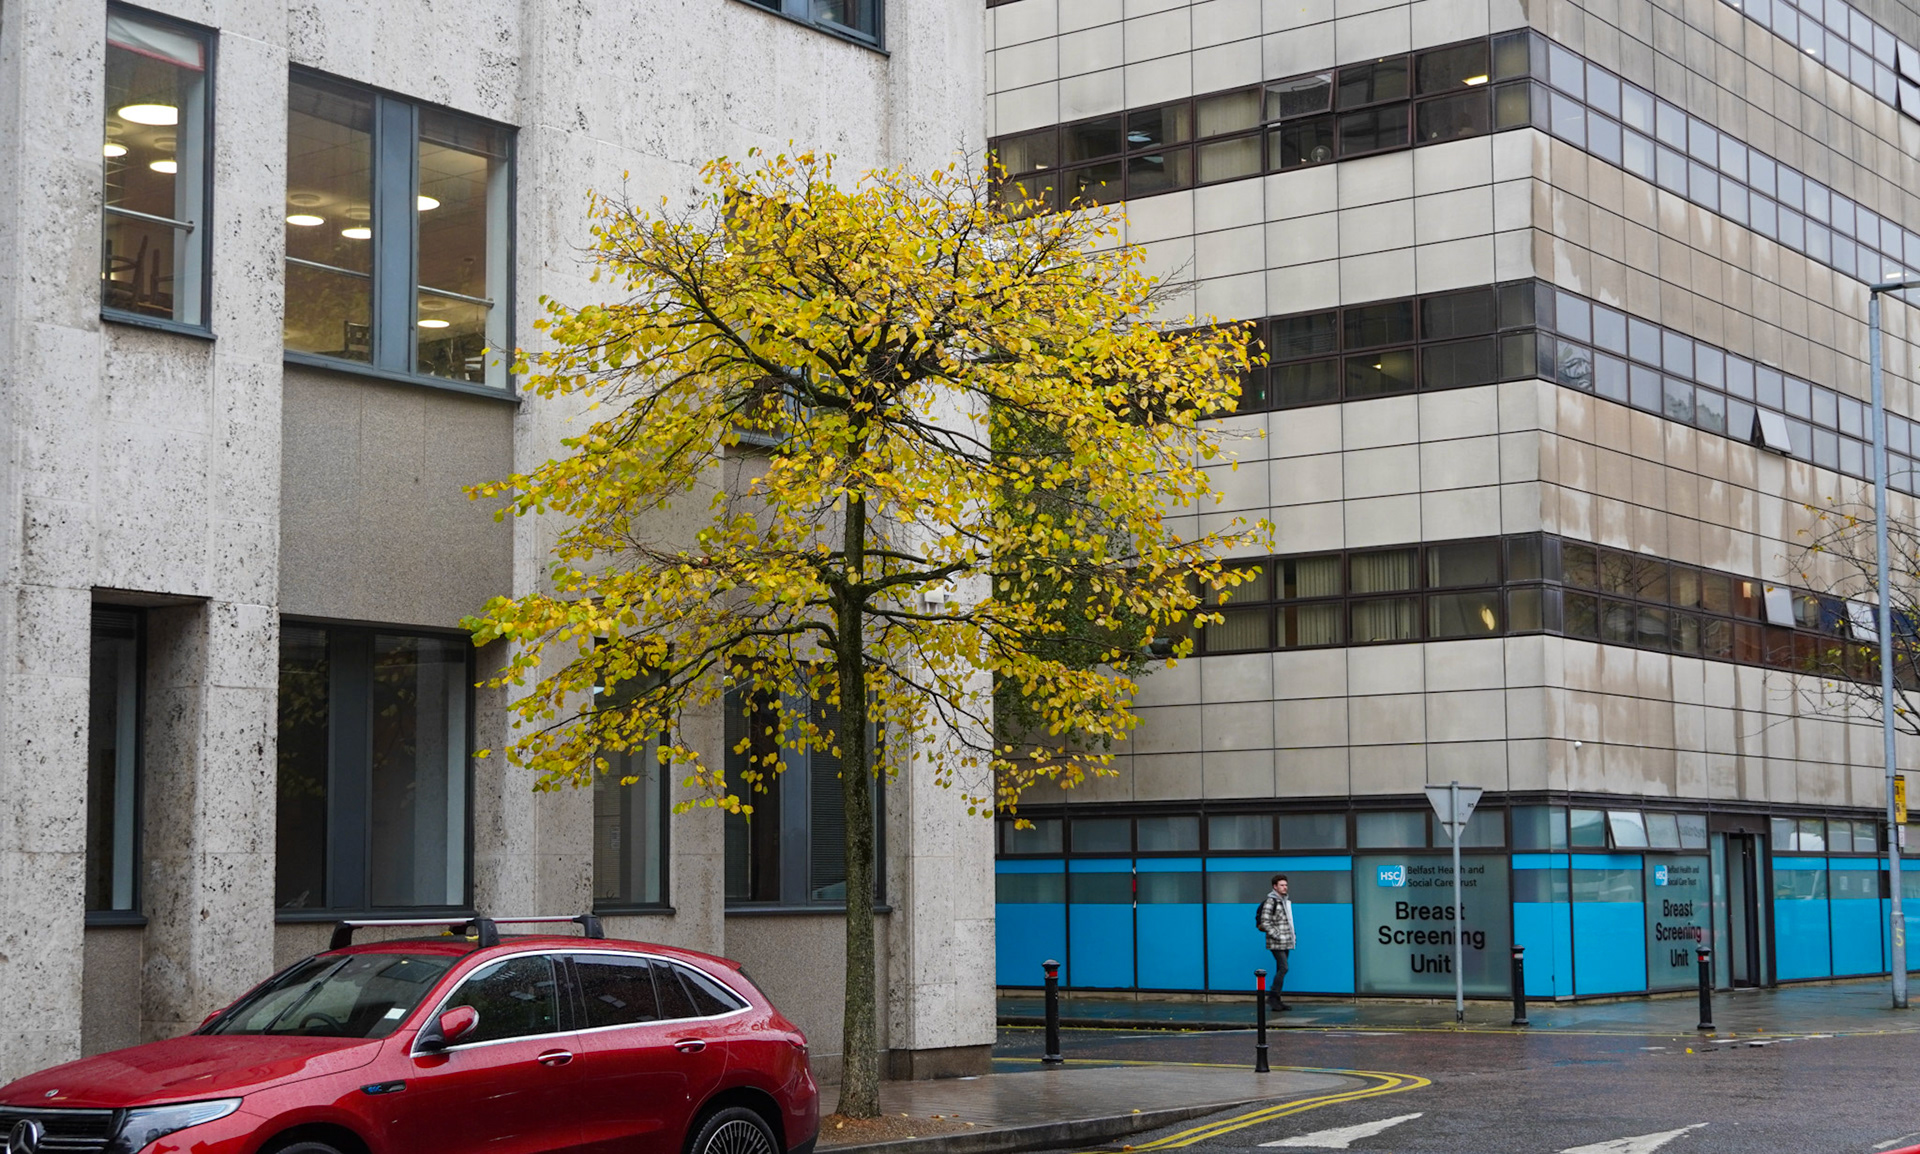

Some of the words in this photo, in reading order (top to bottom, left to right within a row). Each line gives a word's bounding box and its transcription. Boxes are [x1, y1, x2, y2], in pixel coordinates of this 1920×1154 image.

[1380, 871, 1400, 880] HSC
[1407, 865, 1435, 875] Belfast
[1438, 865, 1466, 874] Heah
[1468, 864, 1485, 874] and
[1408, 878, 1433, 887] Social
[1434, 878, 1454, 887] Care
[1459, 879, 1477, 887] rust
[1395, 901, 1465, 920] Breast
[1663, 899, 1693, 917] Breast
[1656, 922, 1702, 943] Screening
[1411, 953, 1451, 973] Unit
[1670, 949, 1689, 967] Unit
